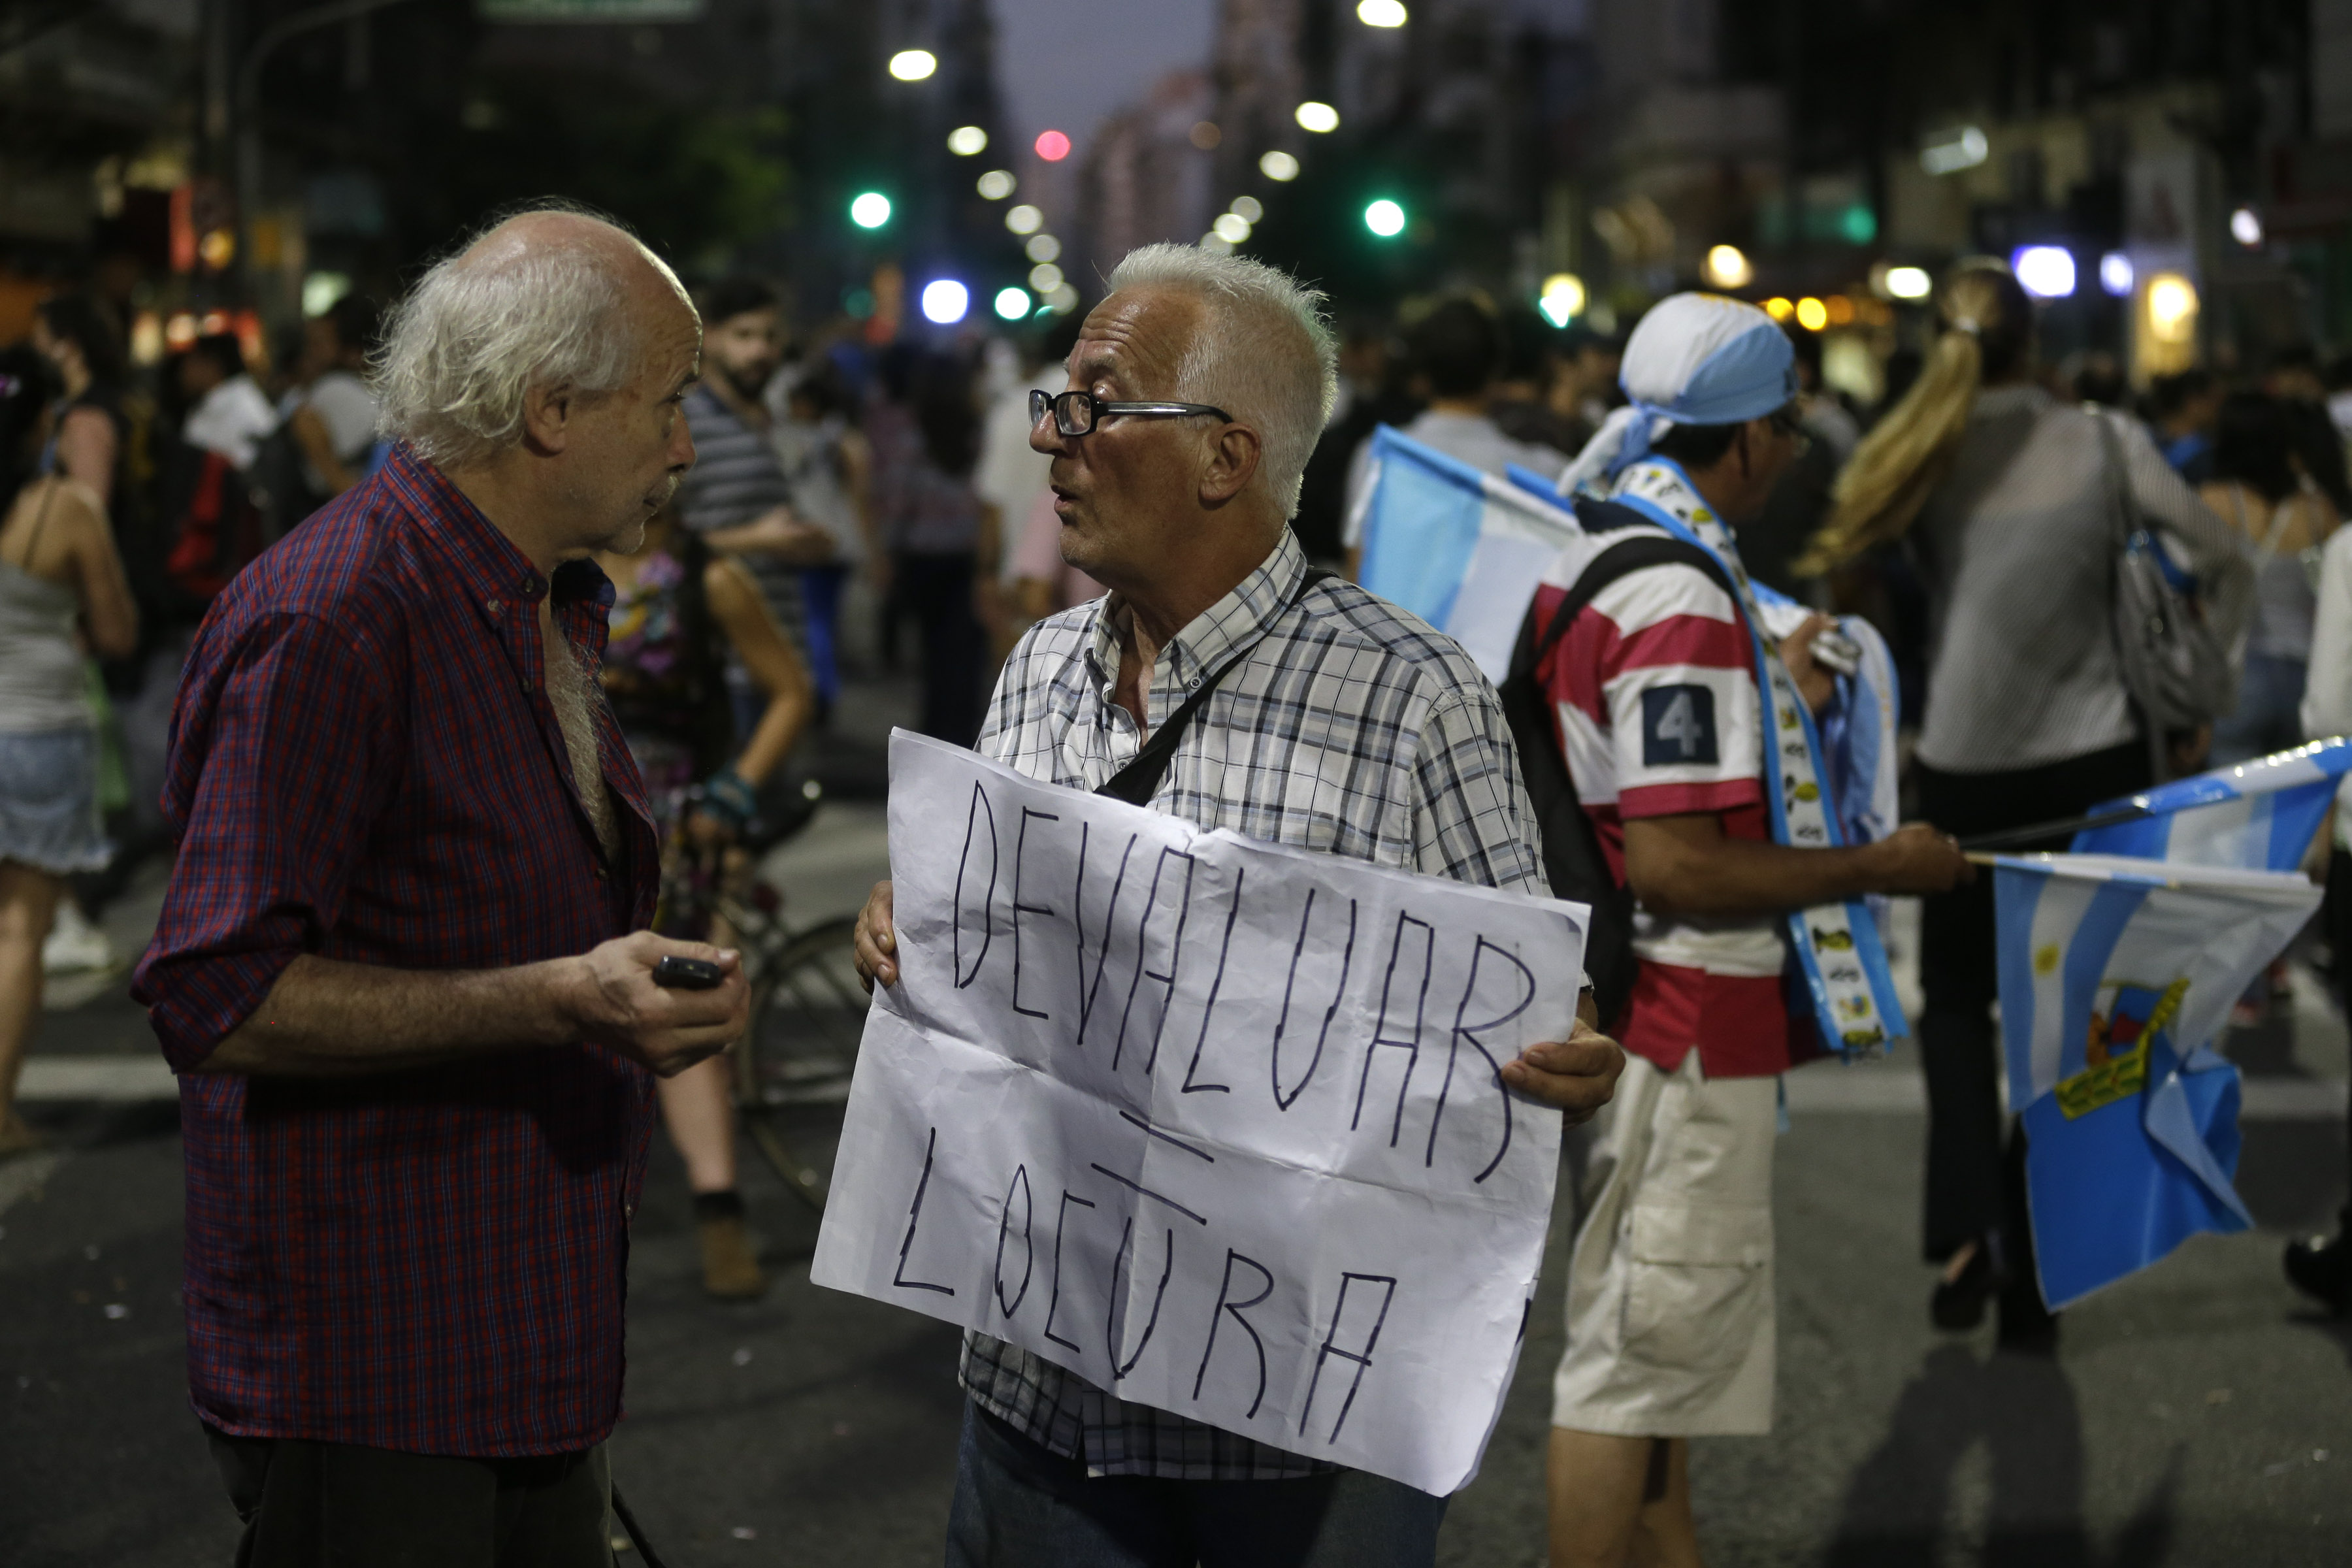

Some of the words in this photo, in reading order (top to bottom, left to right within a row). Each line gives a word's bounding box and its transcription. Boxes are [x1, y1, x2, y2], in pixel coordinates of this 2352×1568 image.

[1656, 690, 1703, 757] 4
[953, 779, 1535, 1184] DEVALUAR
[892, 1126, 1397, 1445] LOCURA
